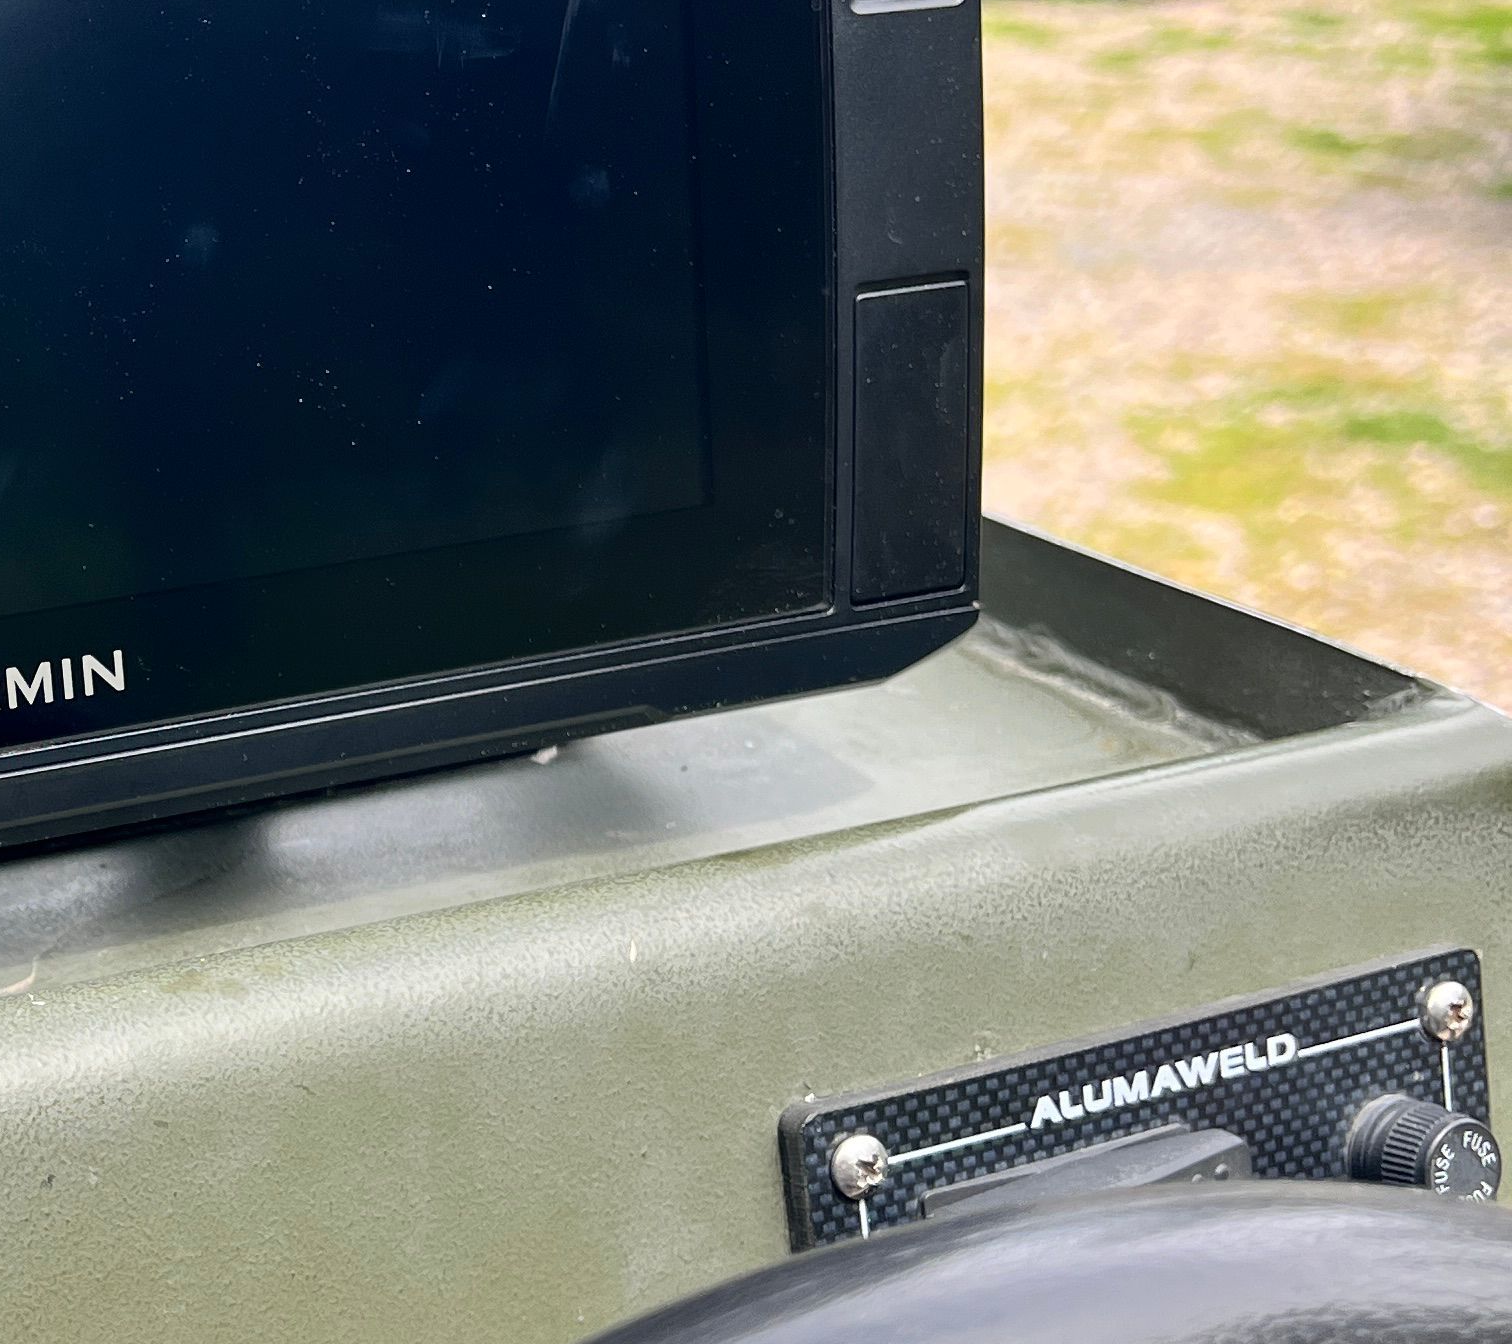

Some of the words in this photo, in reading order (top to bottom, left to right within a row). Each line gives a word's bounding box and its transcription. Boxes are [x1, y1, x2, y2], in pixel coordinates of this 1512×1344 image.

[1028, 1032, 1299, 1130] ALUMAWELD
[1434, 1143, 1456, 1196] FUSE
[1462, 1130, 1497, 1168] FUSE
